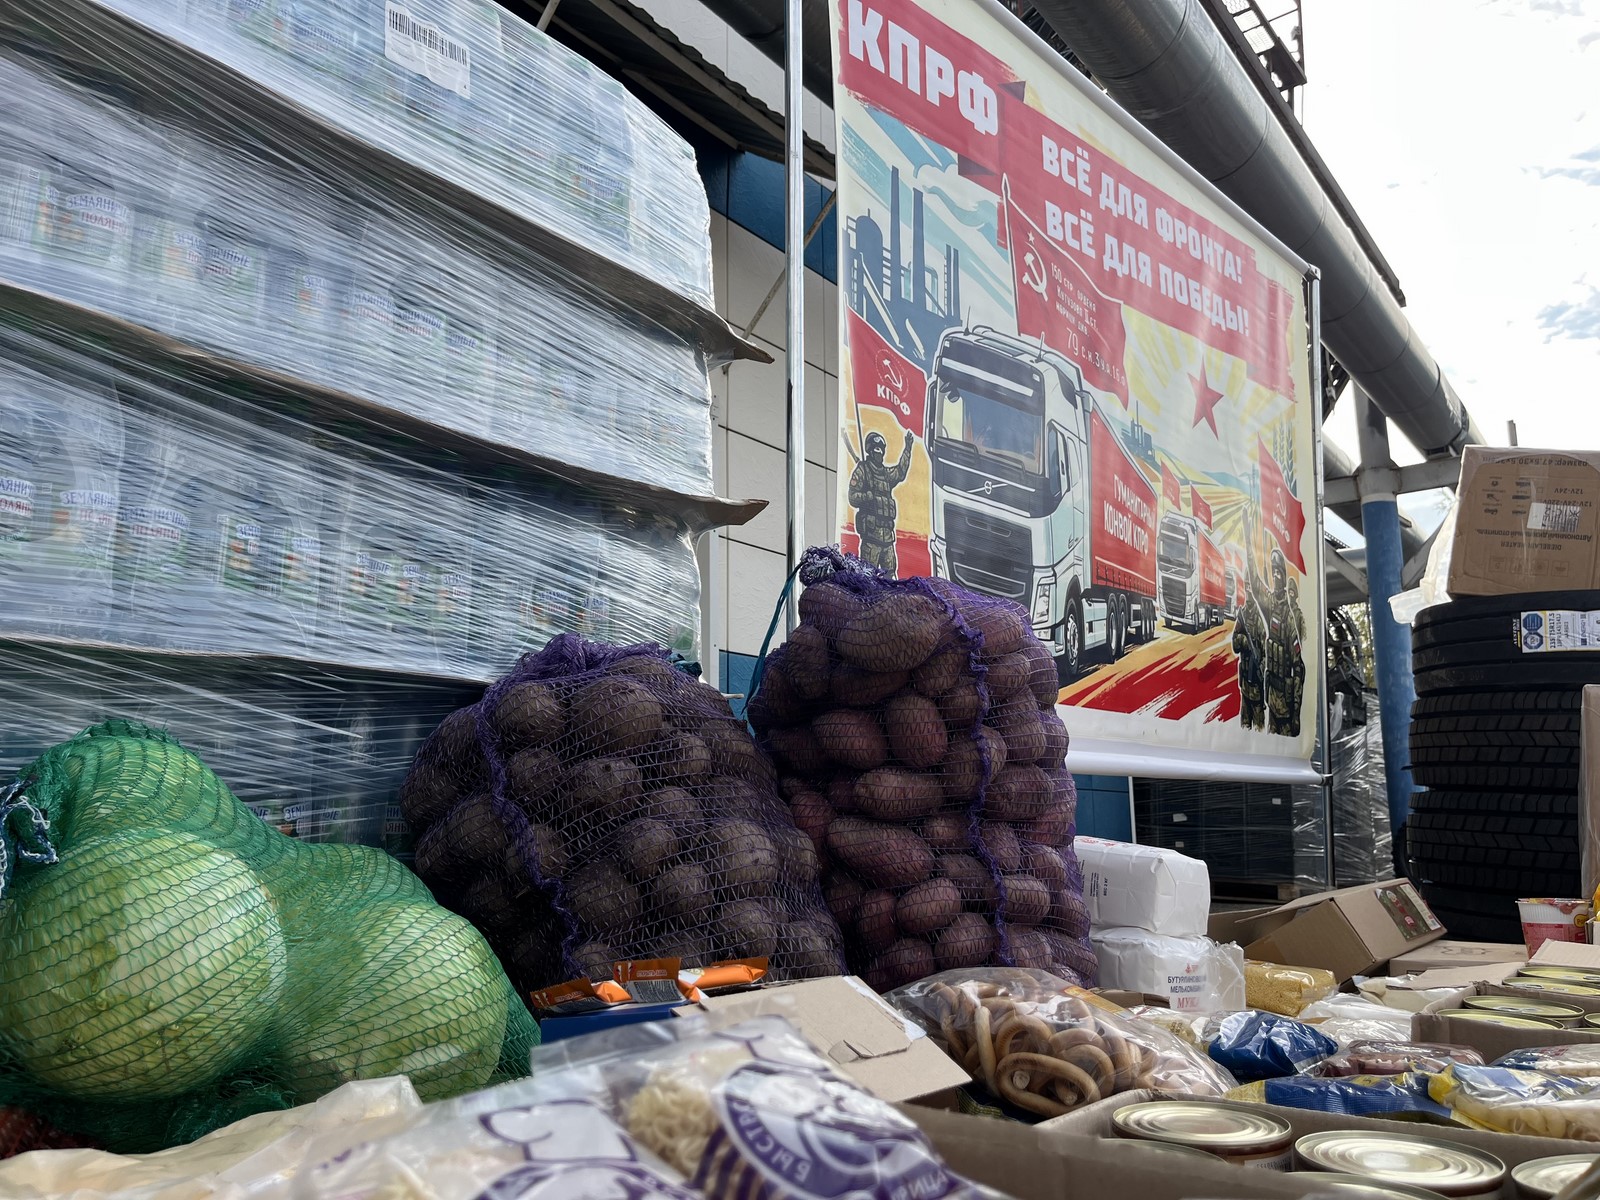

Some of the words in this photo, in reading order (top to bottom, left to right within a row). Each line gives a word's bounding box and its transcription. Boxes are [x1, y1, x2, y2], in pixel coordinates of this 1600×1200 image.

[847, 0, 999, 136] КПРФ
[1041, 135, 1092, 196] ВСЁ
[1099, 173, 1148, 229] ДЛЯ
[1155, 207, 1243, 284] ФРОНТА!
[1044, 200, 1096, 259] ВСЁ
[1103, 235, 1152, 287] ДЛЯ
[1159, 262, 1249, 336] ПОБЕДЫ!
[877, 383, 911, 416] КПРФ
[1104, 500, 1132, 547] КОНВОЙ
